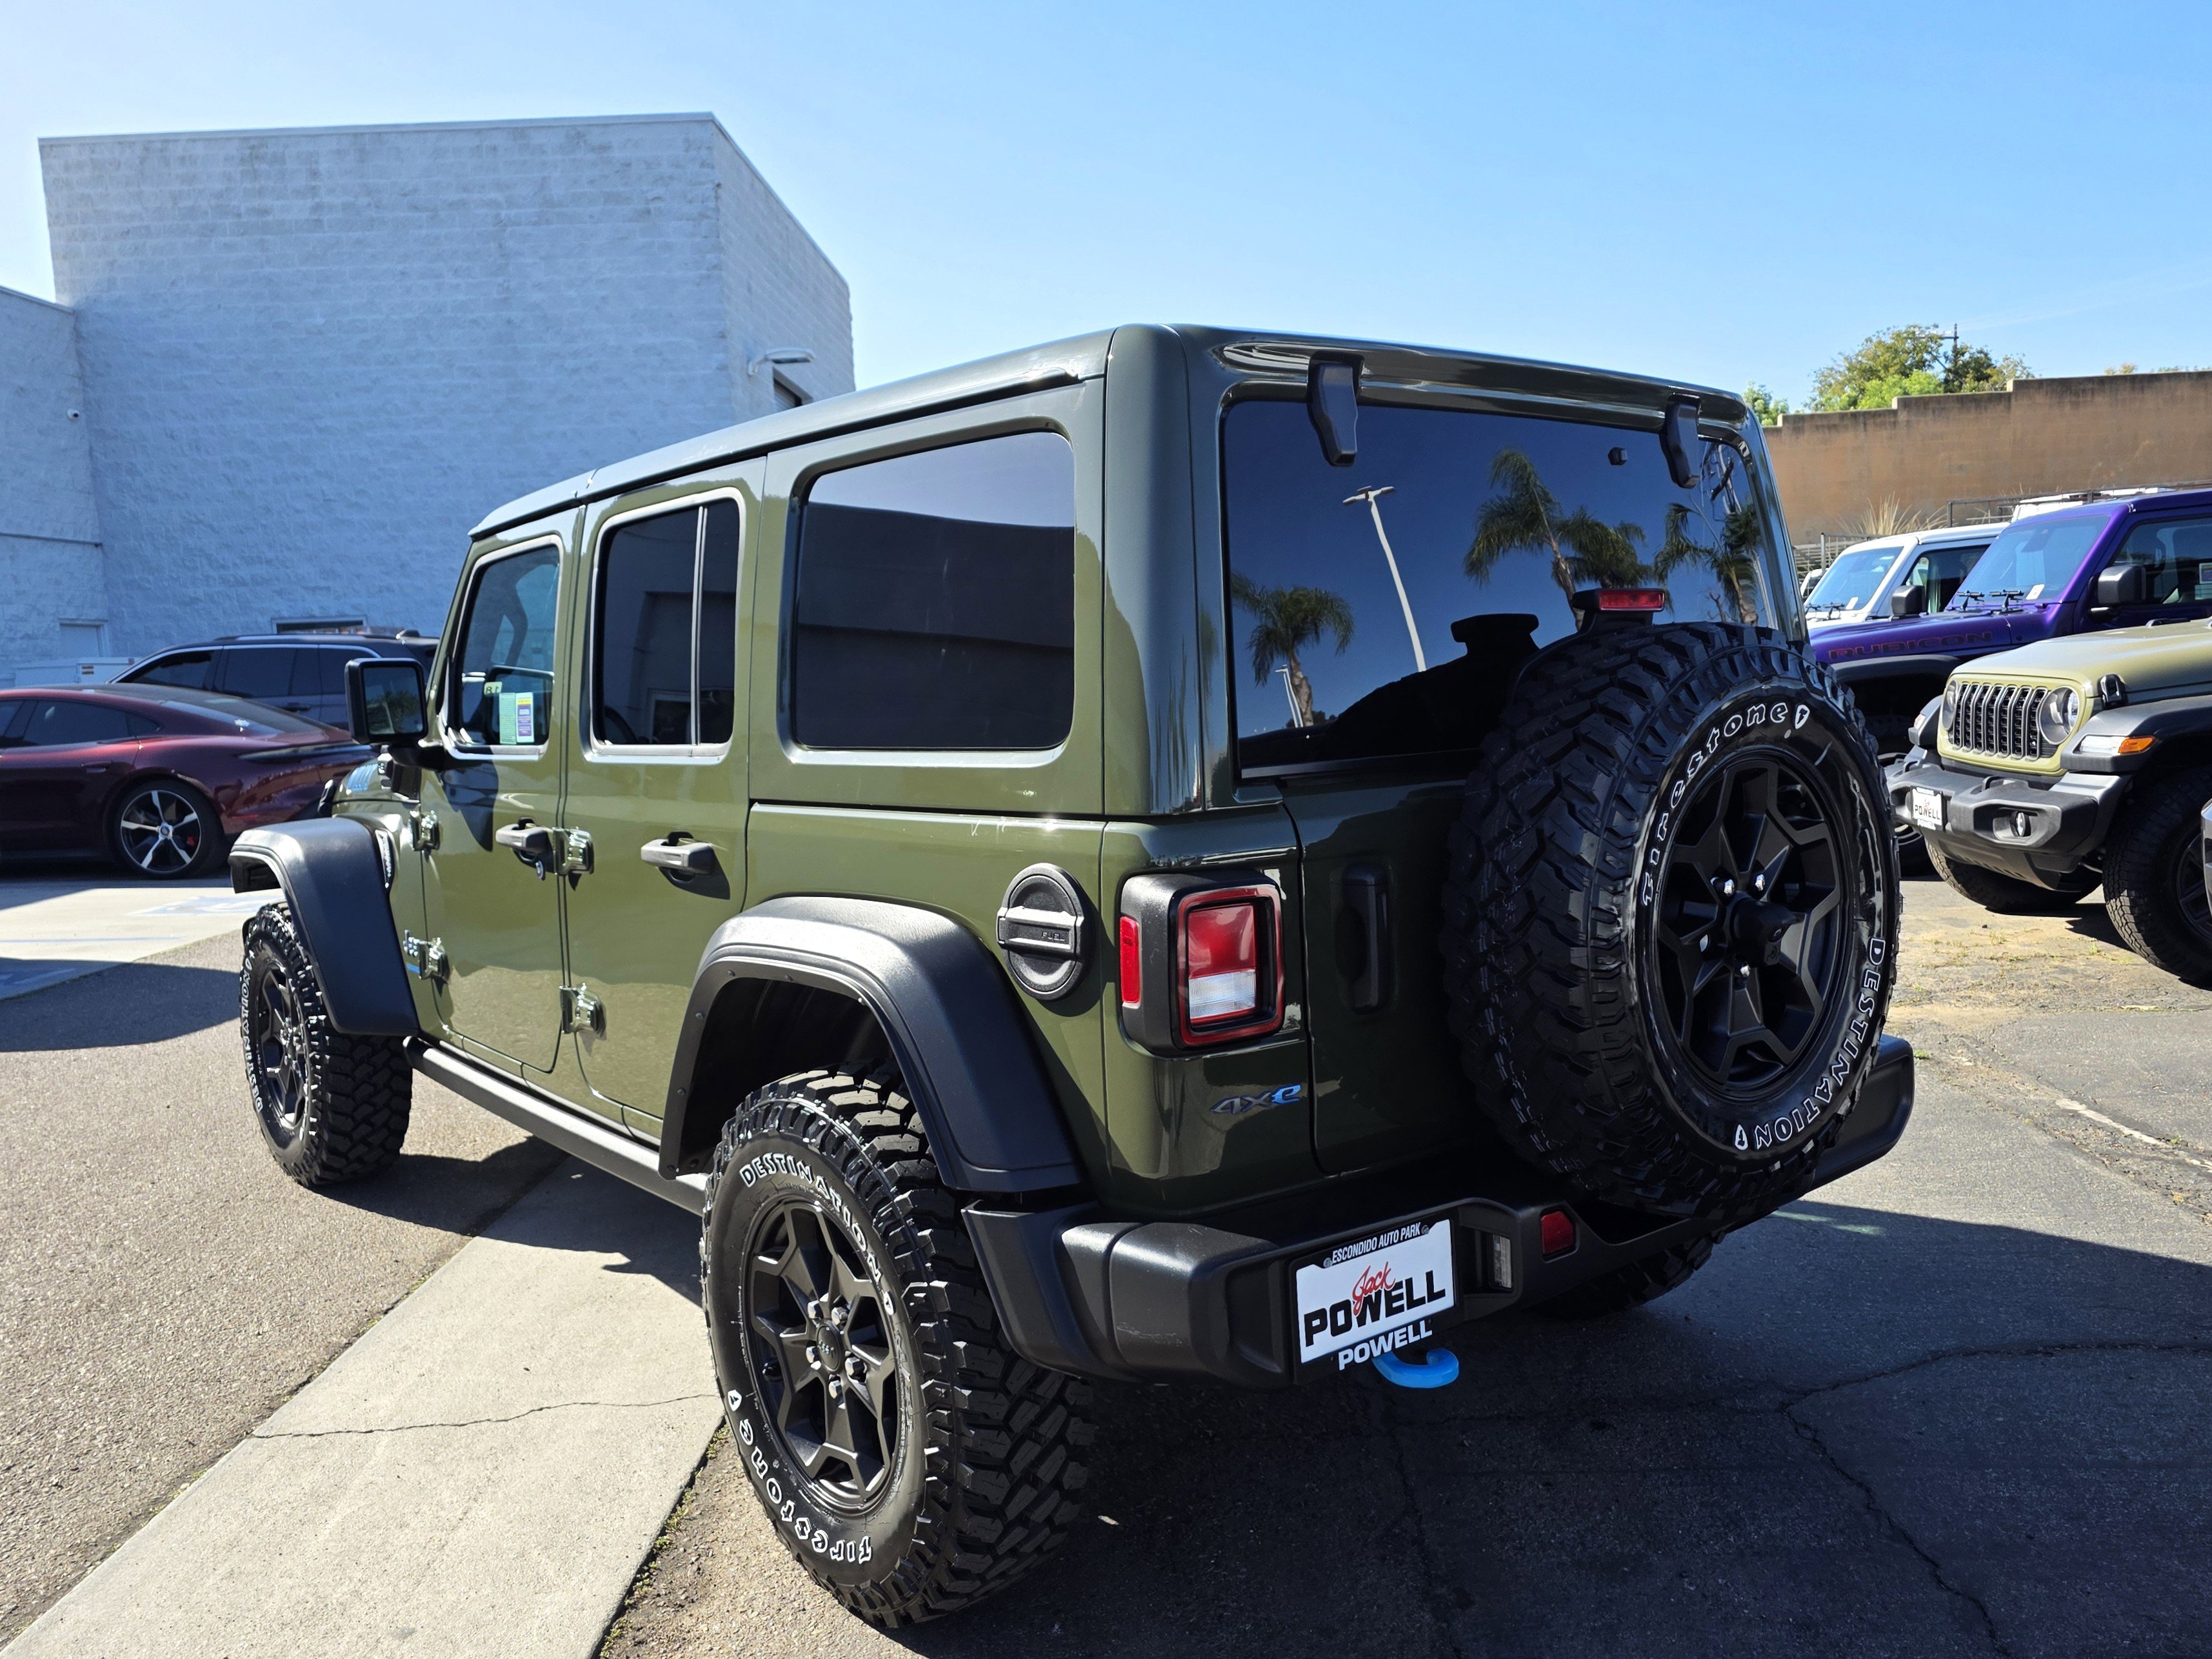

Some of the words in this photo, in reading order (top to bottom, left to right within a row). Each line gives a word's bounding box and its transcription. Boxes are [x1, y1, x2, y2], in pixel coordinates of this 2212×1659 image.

[1828, 632, 1993, 659] RUBICON
[1915, 805, 1940, 820] POWELL
[1041, 932, 1065, 941] FUEL
[239, 968, 263, 1113] DESTINATION
[1755, 936, 1886, 1151] DESTINATION
[739, 1152, 883, 1285] DESTINATION
[1331, 1237, 1378, 1264] ESCONDIDO
[1378, 1229, 1399, 1248] AUTO
[1400, 1222, 1421, 1241] PARK
[1303, 1270, 1446, 1347] POWELL
[1351, 1262, 1396, 1316] Jack
[1338, 1320, 1433, 1371] POWELL
[739, 1418, 872, 1565] Firestone
